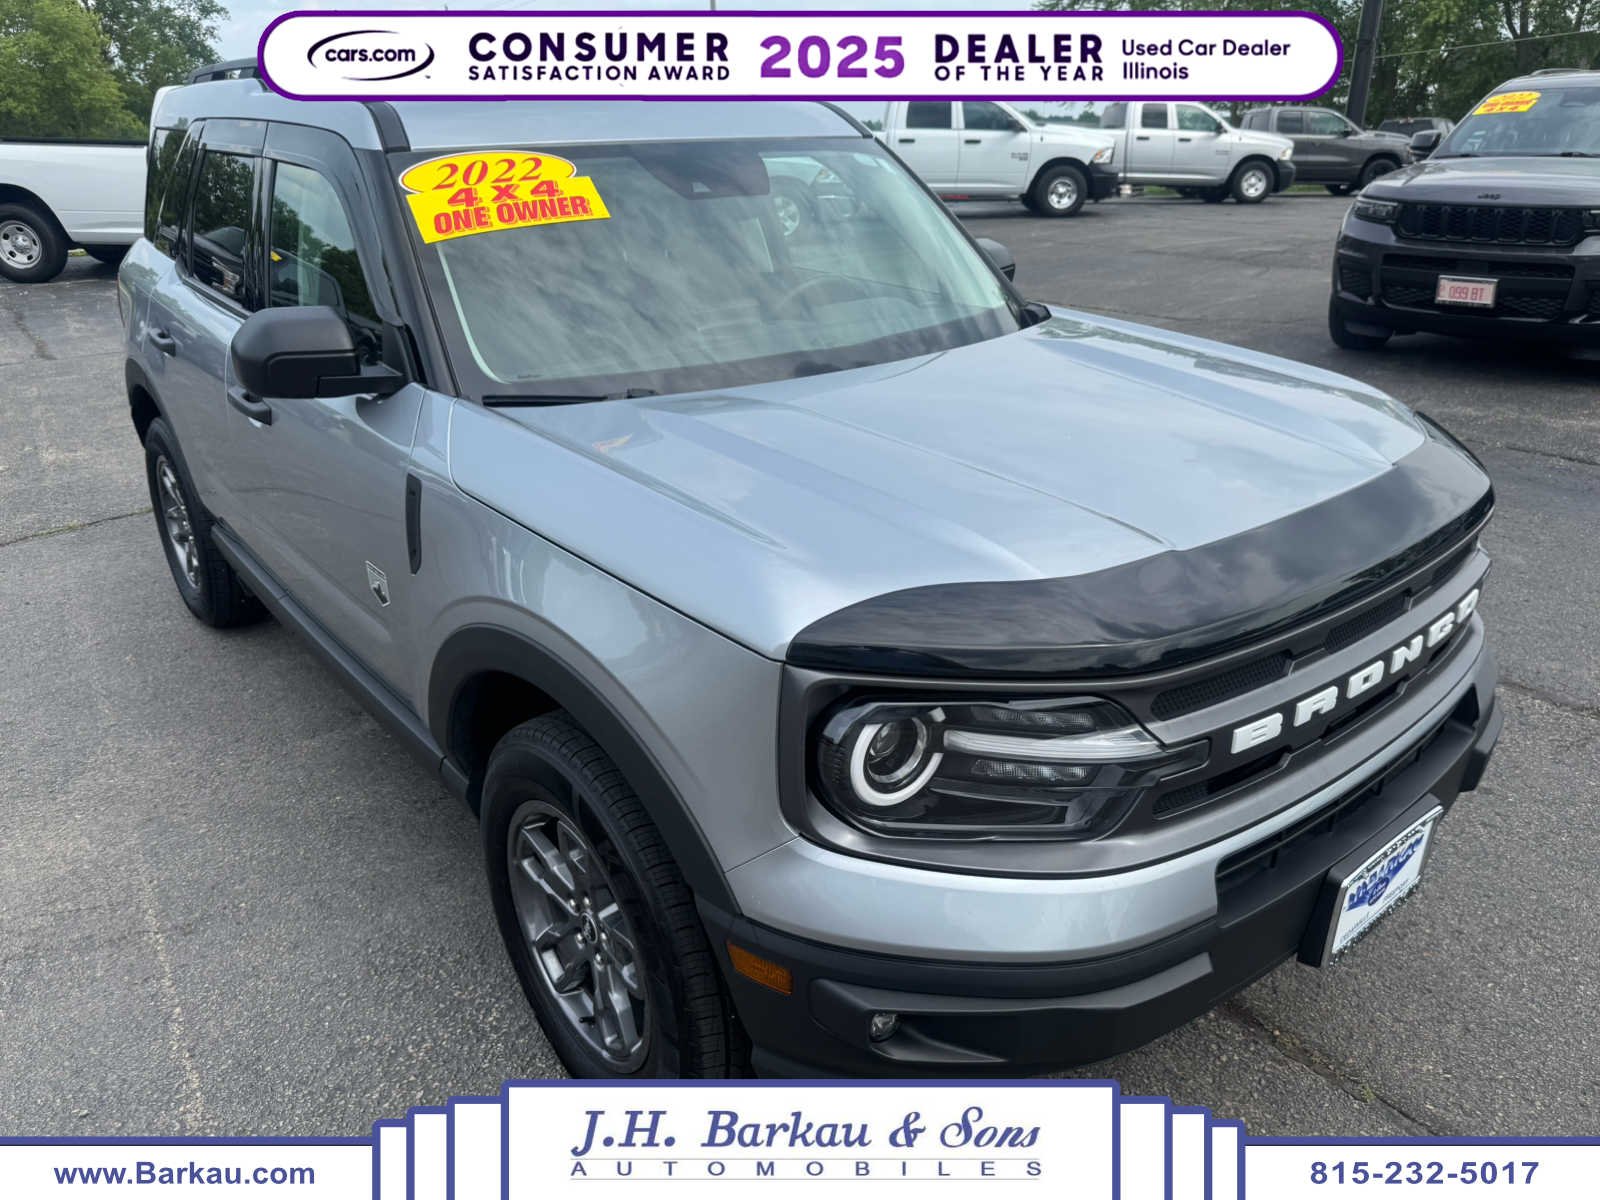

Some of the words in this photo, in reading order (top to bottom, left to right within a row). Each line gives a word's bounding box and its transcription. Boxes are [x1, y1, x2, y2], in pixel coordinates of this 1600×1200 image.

[432, 157, 543, 191] 2022
[434, 207, 494, 236] ONE
[496, 196, 594, 224] OWNER
[1230, 588, 1480, 755] BRONCO
